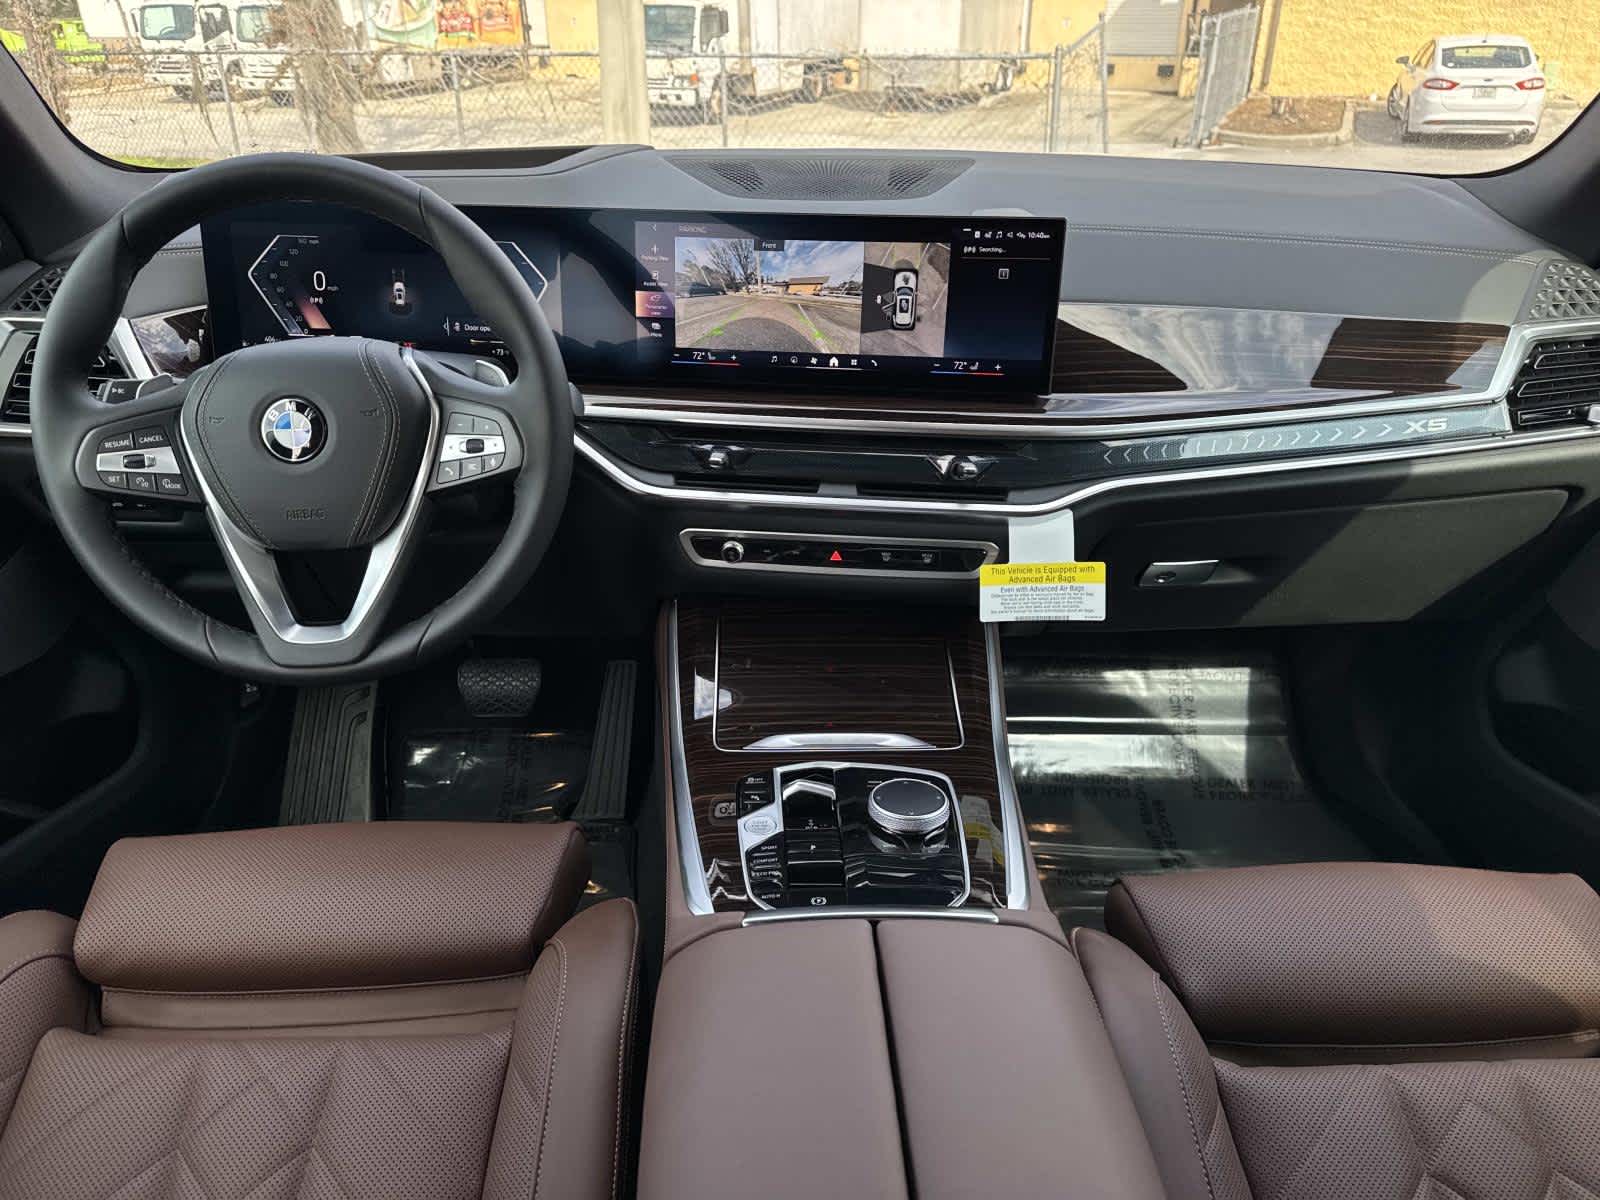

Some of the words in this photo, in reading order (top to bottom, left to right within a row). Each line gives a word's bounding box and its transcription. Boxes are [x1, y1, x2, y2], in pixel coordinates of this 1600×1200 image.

[313, 271, 326, 292] 0
[1402, 417, 1448, 434] X5
[104, 440, 130, 449] RESUME
[138, 435, 164, 444] CANCEL
[108, 475, 120, 483] SET
[991, 567, 1006, 575] This
[1008, 567, 1034, 575] Vehicle
[1043, 566, 1077, 576] Equipped
[1079, 565, 1095, 573] with
[1009, 575, 1044, 584] Advanced
[1045, 575, 1055, 583] Air
[1057, 574, 1076, 583] Bags
